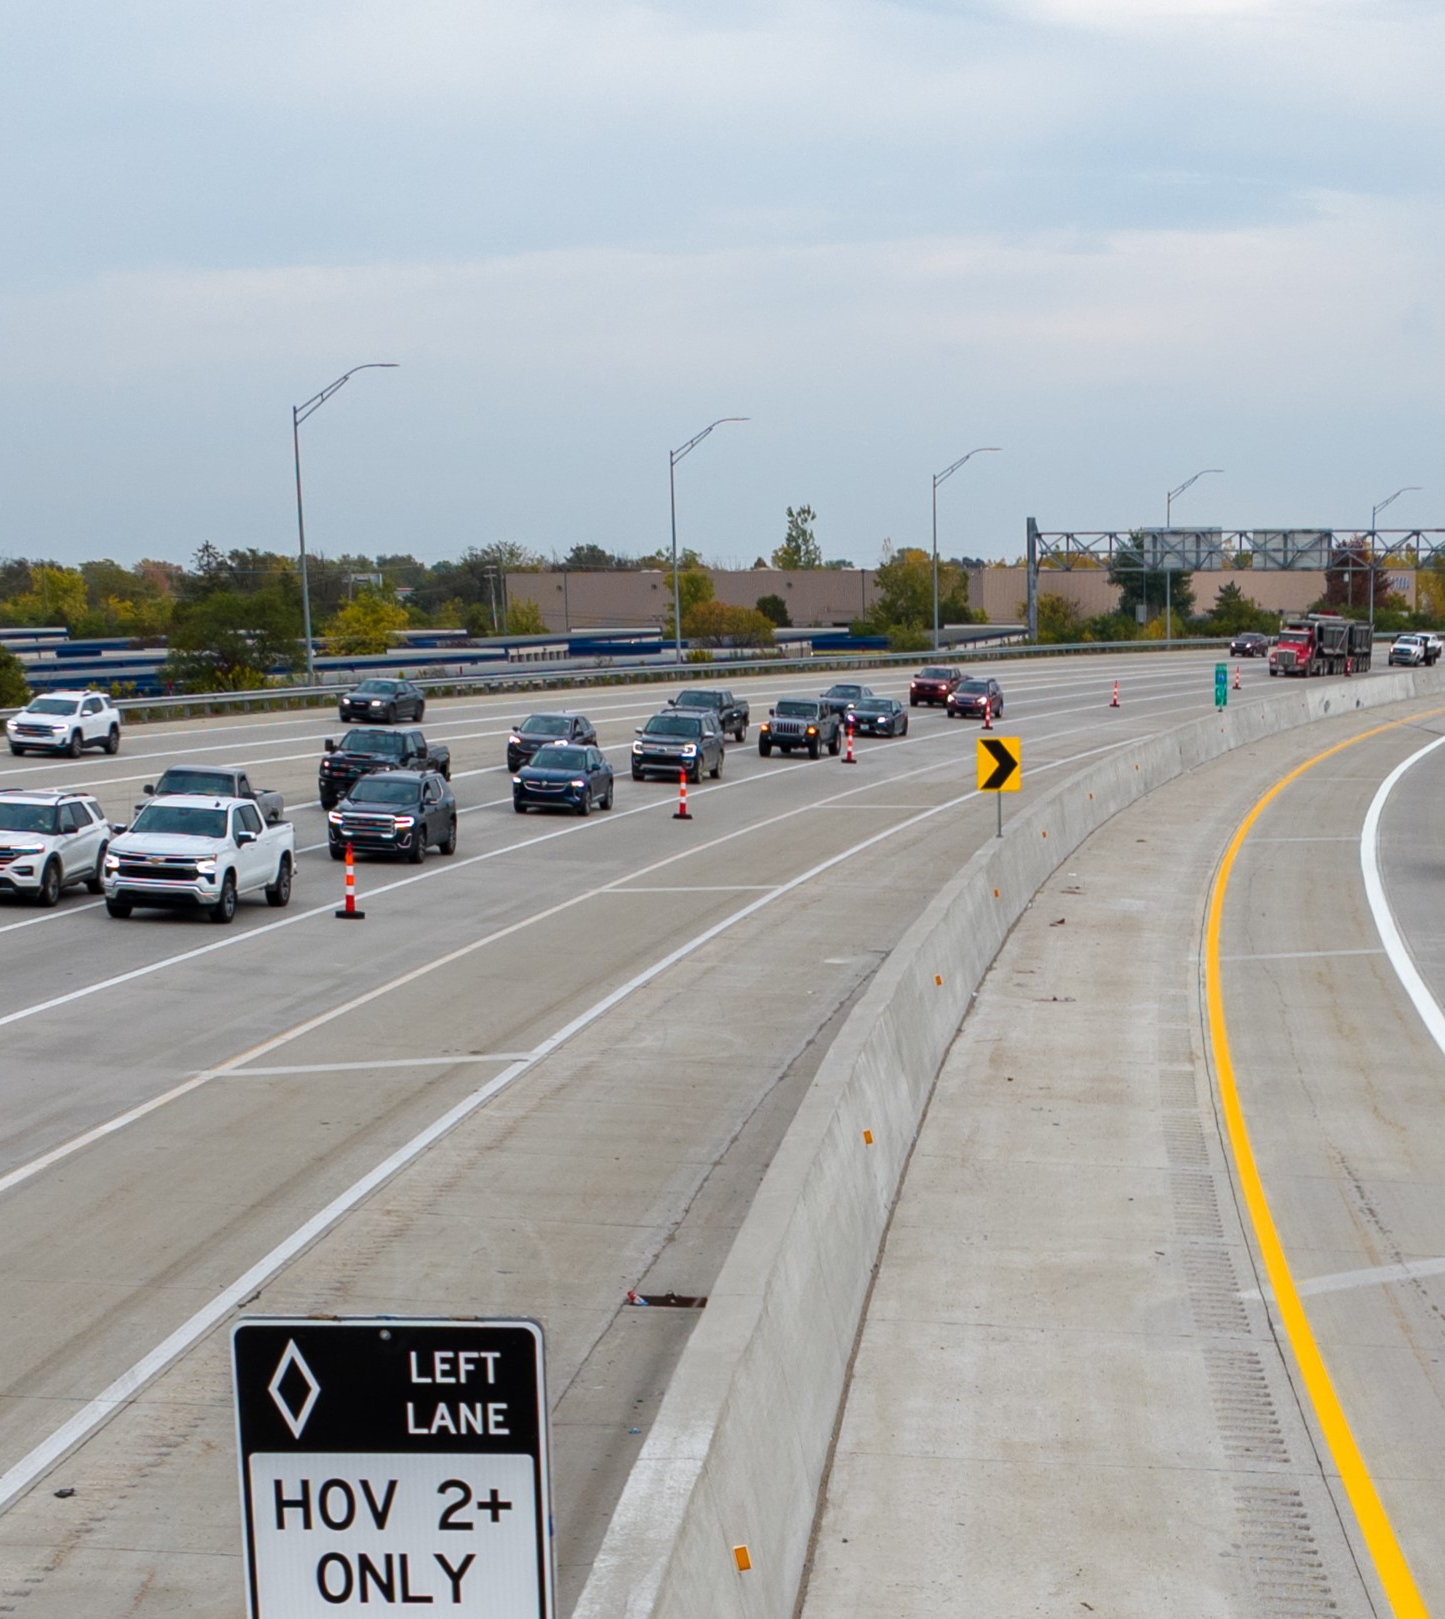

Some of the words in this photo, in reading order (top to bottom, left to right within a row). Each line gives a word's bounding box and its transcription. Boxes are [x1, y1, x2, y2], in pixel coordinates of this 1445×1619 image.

[410, 1351, 501, 1384] LEFT
[406, 1402, 510, 1435] LANE
[273, 1477, 399, 1531] HOV
[436, 1478, 513, 1531] 2+
[315, 1551, 476, 1604] ONLY
